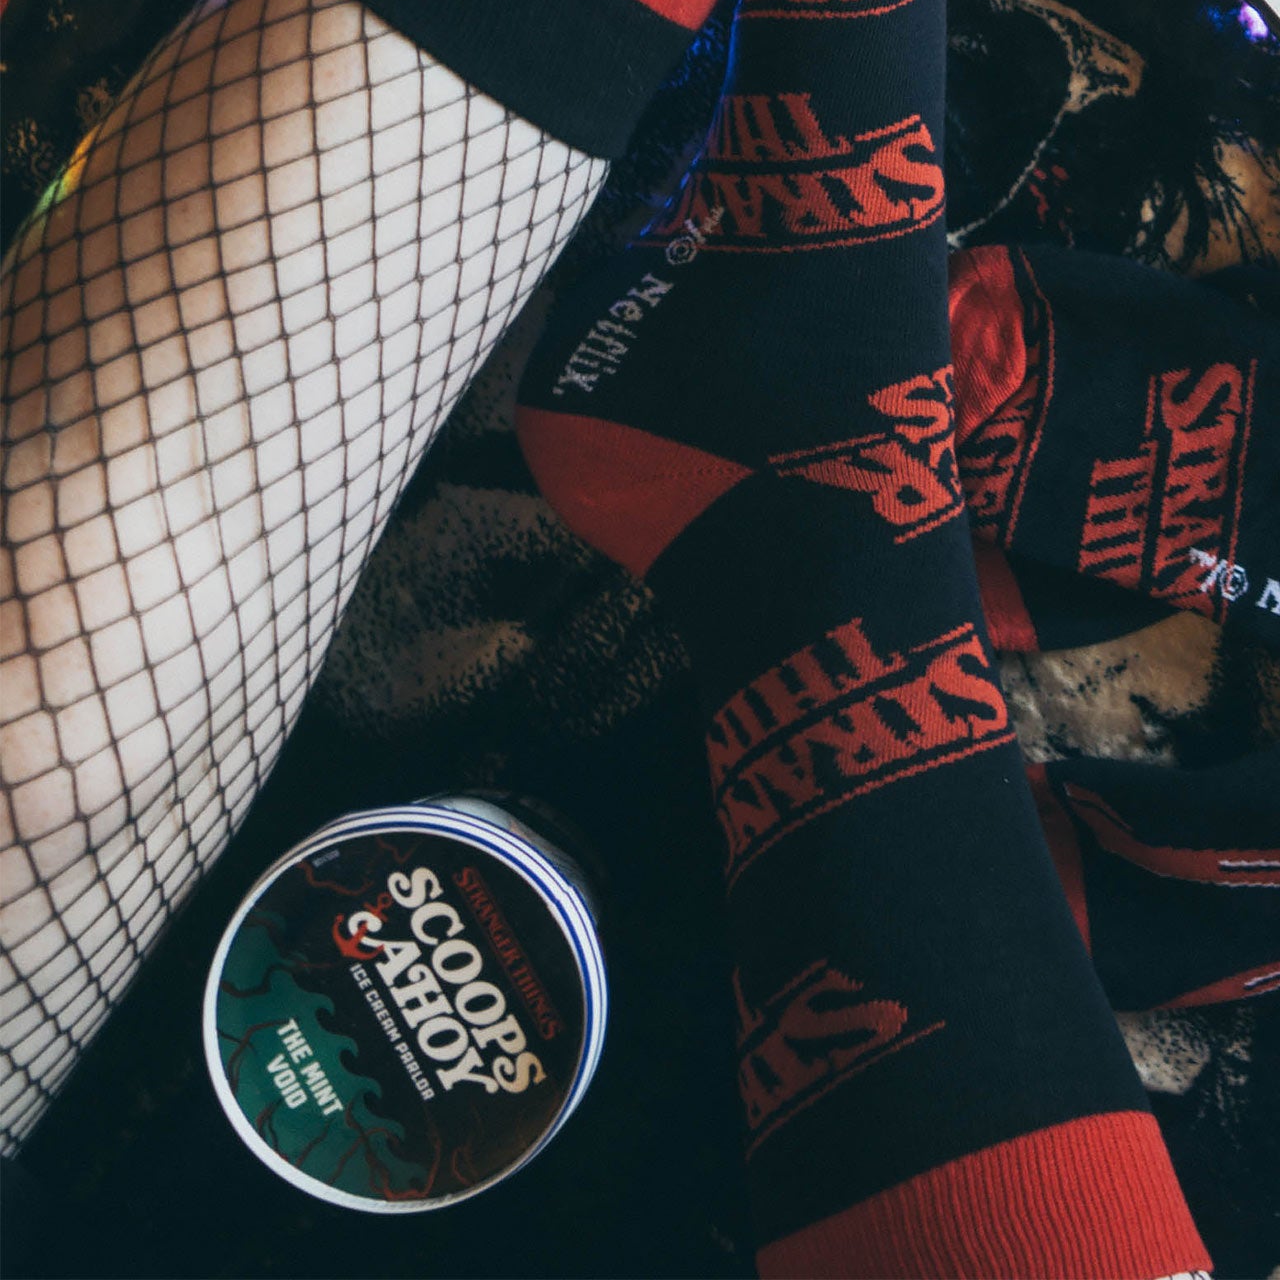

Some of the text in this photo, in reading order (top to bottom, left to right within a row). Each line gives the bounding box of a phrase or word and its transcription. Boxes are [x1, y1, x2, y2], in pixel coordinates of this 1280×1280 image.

[348, 910, 500, 1094] AHOY
[350, 963, 436, 1101] ICE CREAM PARLOR
[388, 867, 547, 1094] SCOOPS
[266, 1053, 308, 1110] VOID
[276, 1018, 344, 1116] THE MINT
